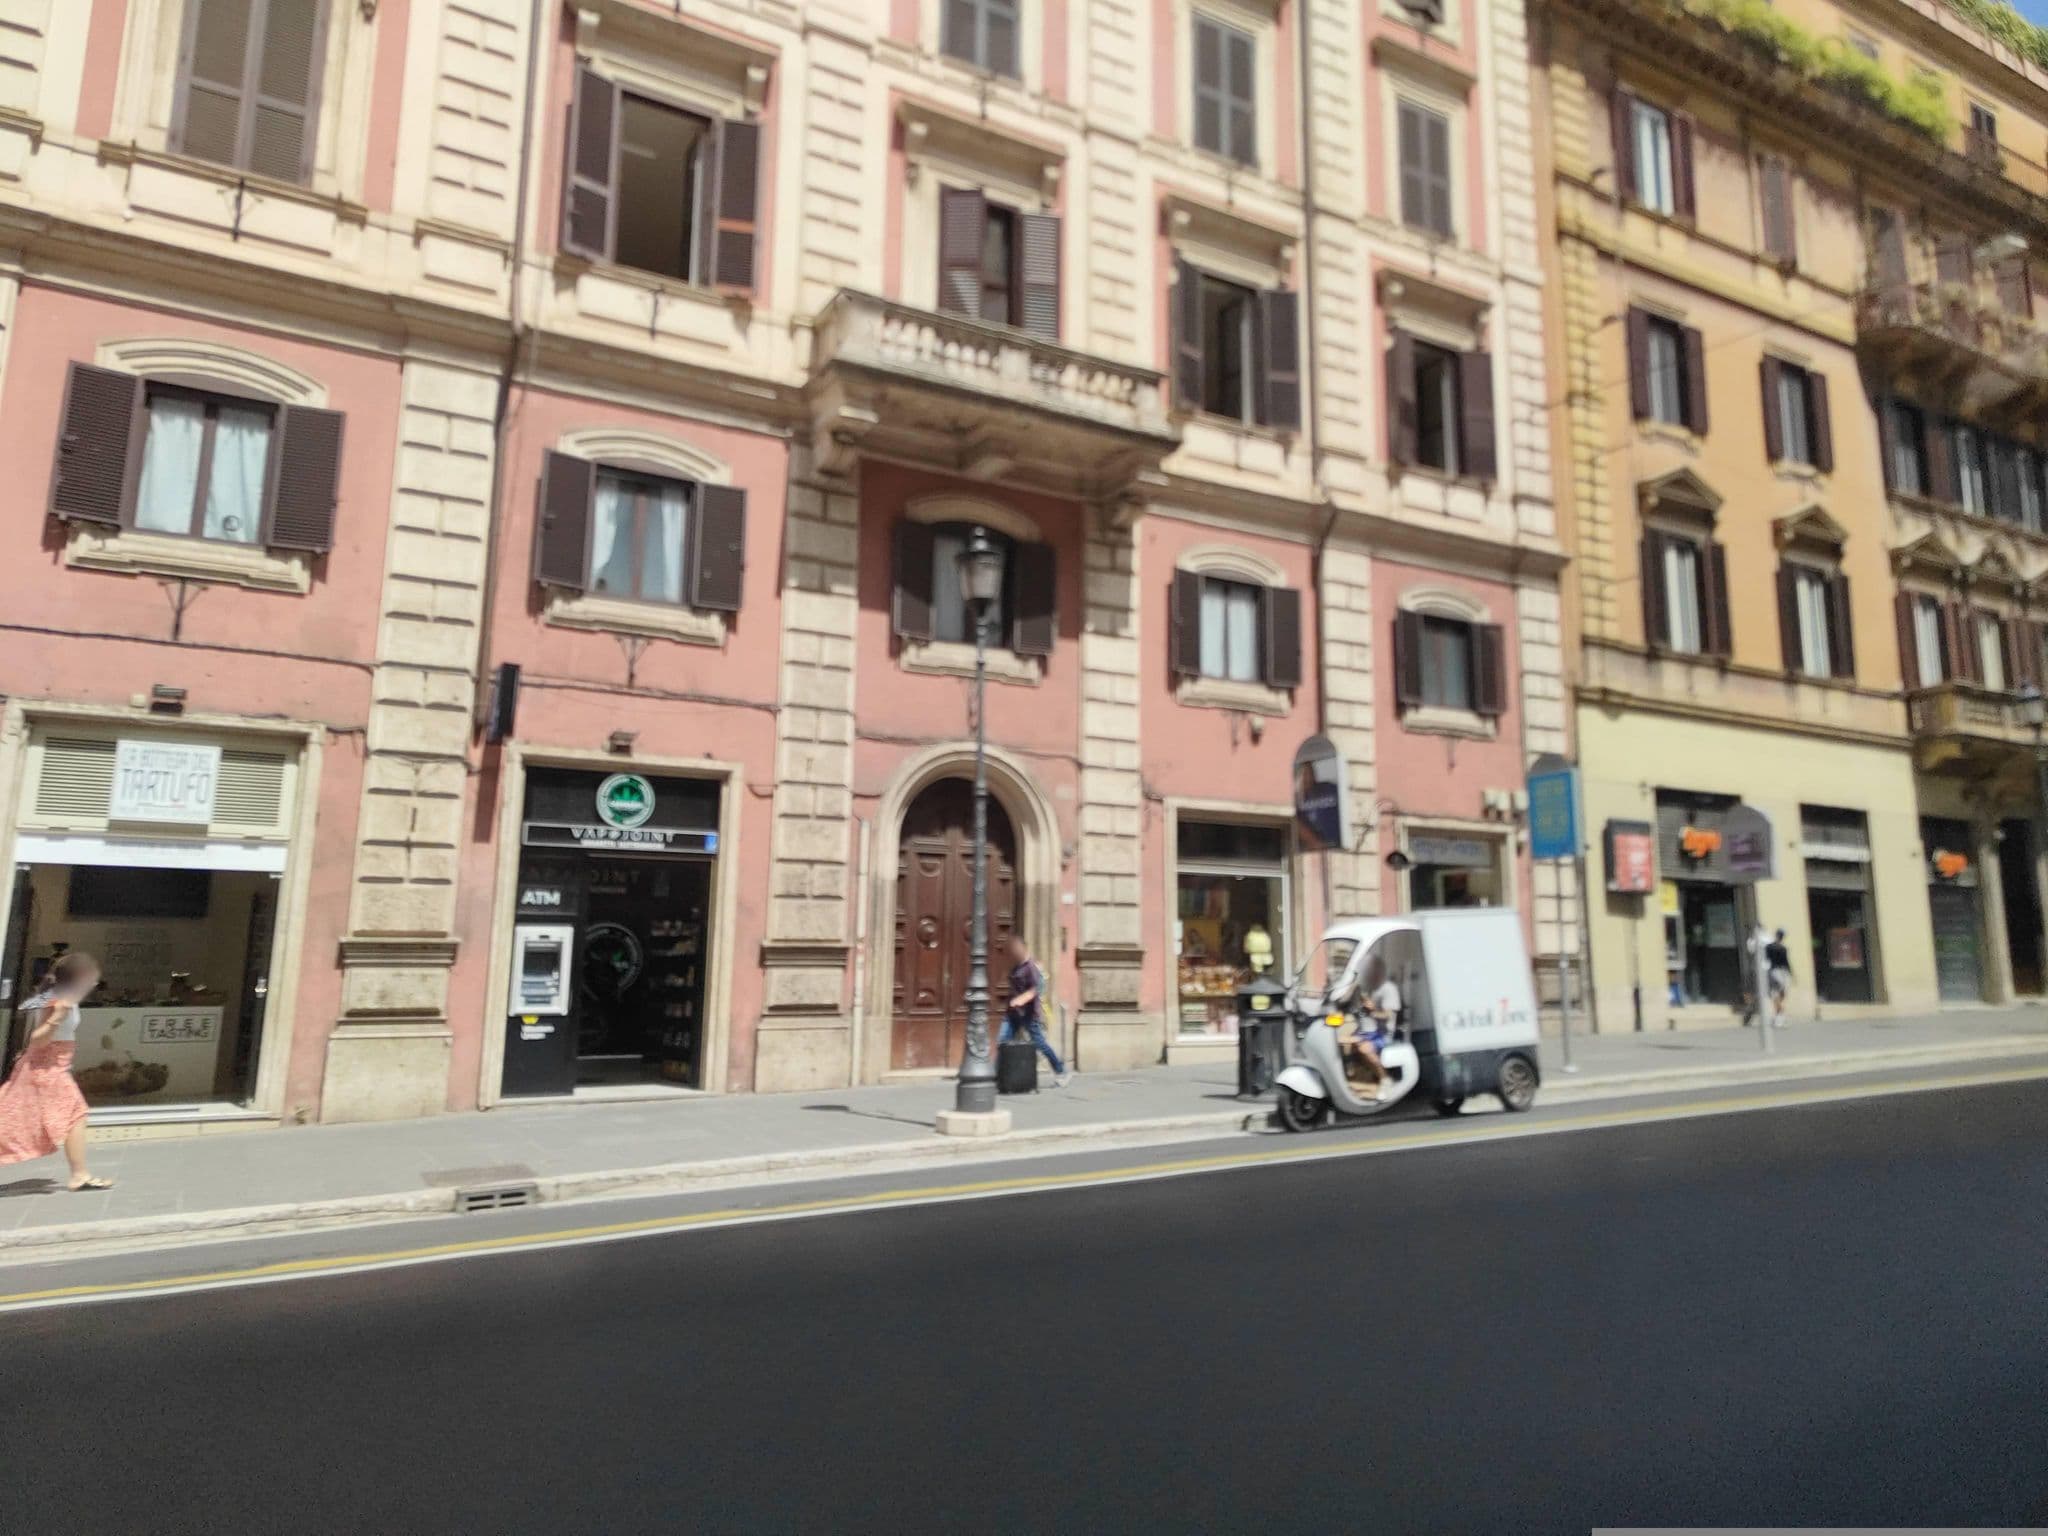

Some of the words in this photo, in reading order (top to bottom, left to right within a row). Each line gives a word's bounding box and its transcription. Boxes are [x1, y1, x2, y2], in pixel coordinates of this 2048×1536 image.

[120, 767, 211, 804] TARTUFO
[521, 888, 561, 906] ATM
[147, 1018, 213, 1032] FREE
